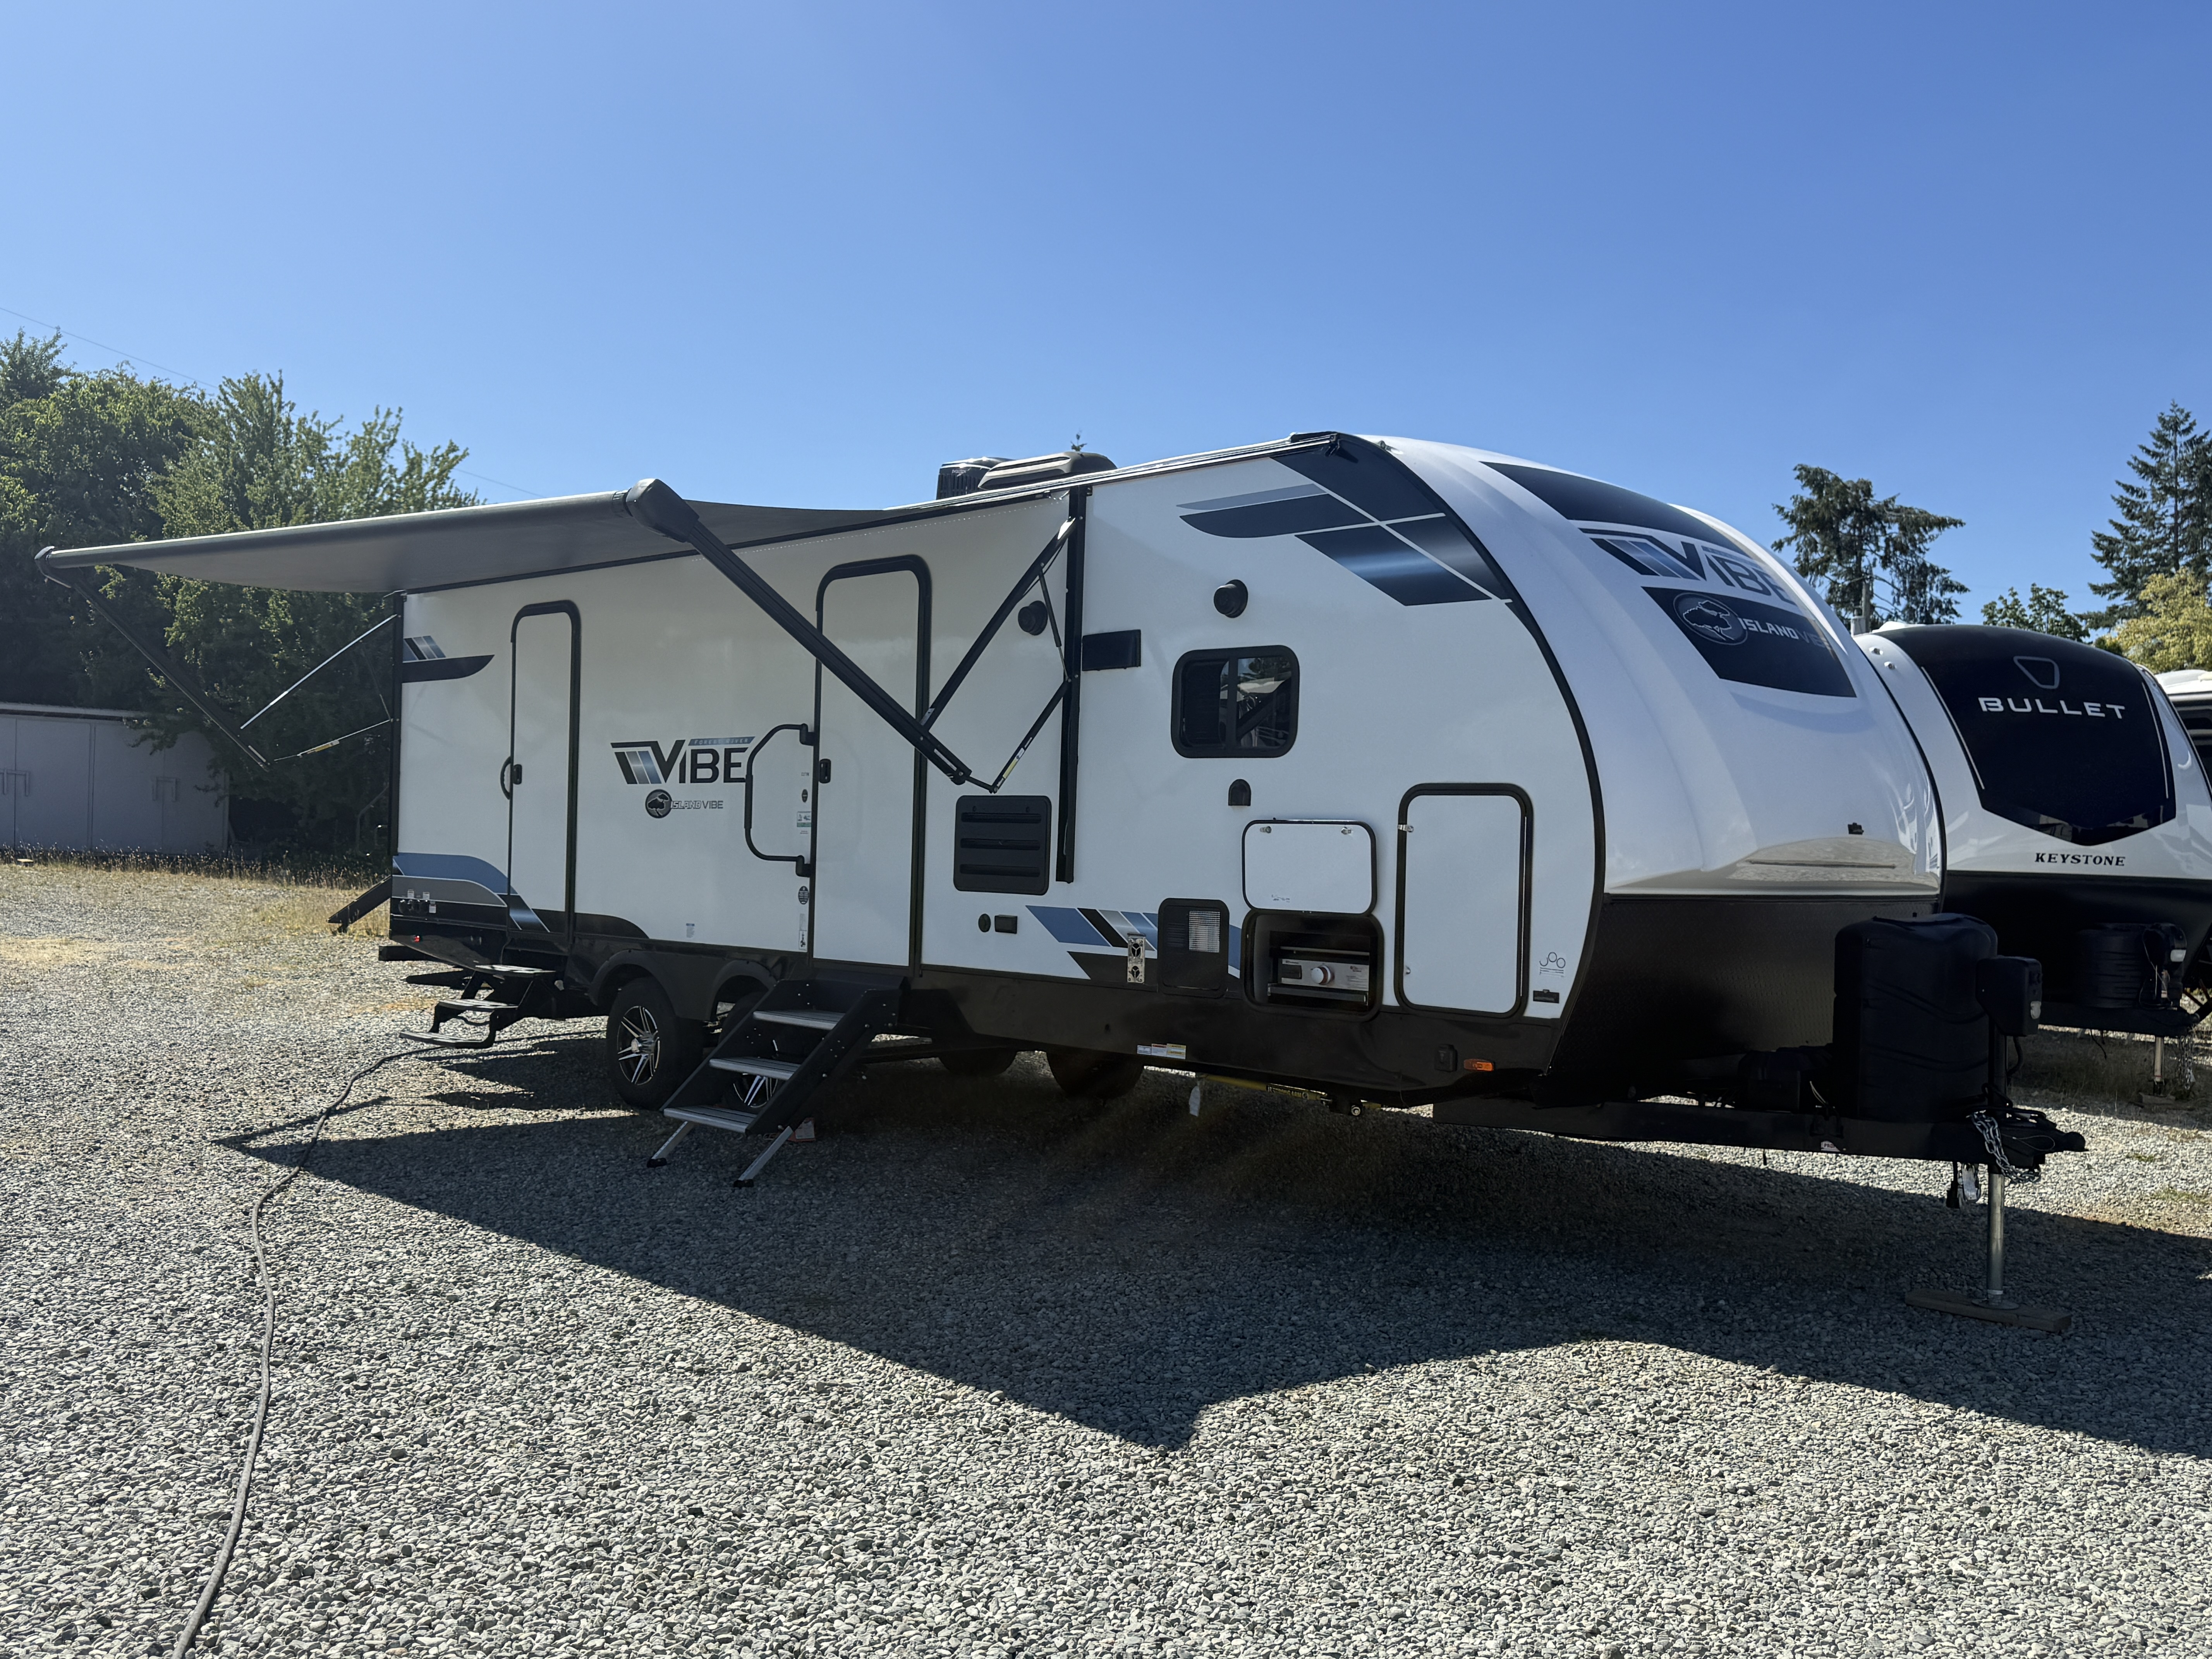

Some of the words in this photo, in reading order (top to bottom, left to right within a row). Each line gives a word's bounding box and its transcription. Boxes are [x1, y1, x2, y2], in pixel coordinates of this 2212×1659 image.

[1579, 528, 1797, 606] VIBE
[1739, 618, 1799, 640] ISLAND
[1978, 697, 2126, 719] BULLET
[610, 739, 749, 784] VIBE
[670, 800, 701, 809] ISLAND
[701, 800, 724, 809] VIBE
[2034, 852, 2126, 867] KEYSTONE
